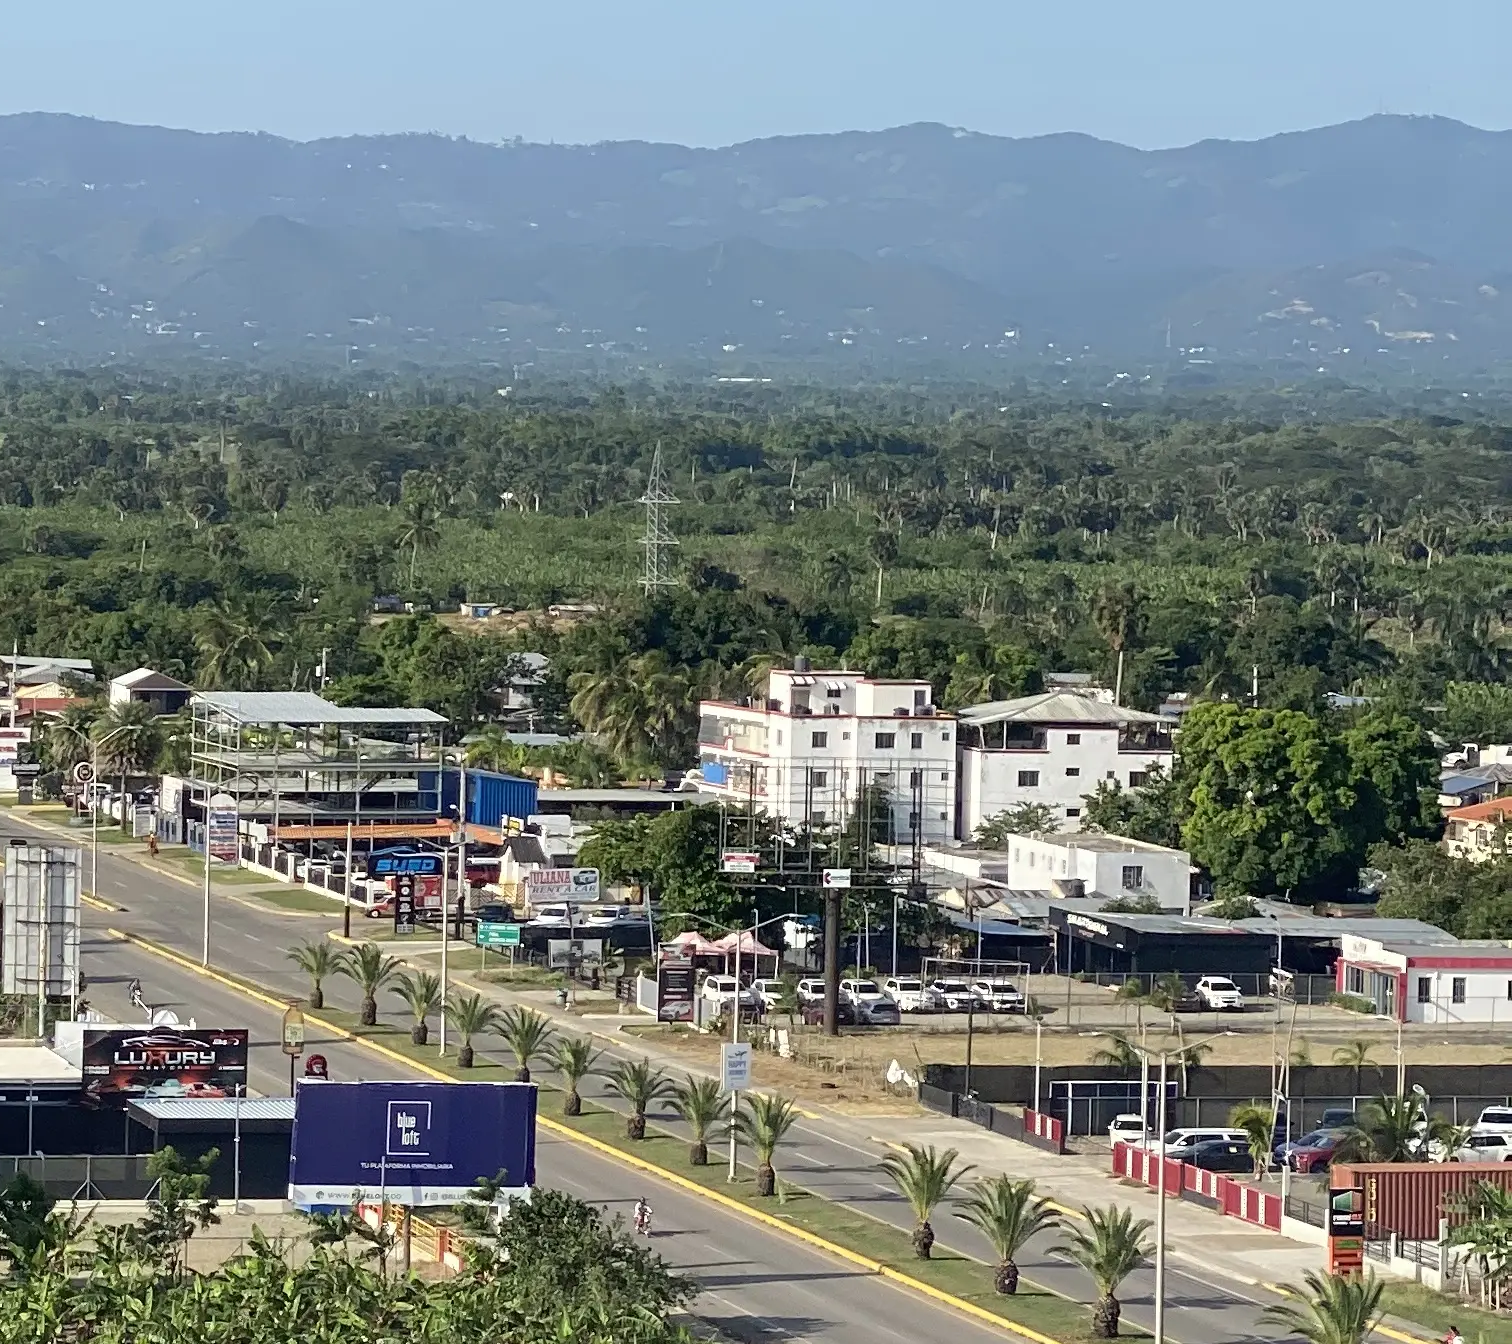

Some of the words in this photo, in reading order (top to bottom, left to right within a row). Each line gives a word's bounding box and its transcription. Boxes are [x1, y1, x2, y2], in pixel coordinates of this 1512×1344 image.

[529, 870, 572, 886] JULIANA
[532, 885, 561, 894] RENT
[563, 885, 572, 893] A
[113, 1051, 216, 1065] LUXURY
[397, 1111, 417, 1129] blue
[401, 1128, 421, 1146] loft
